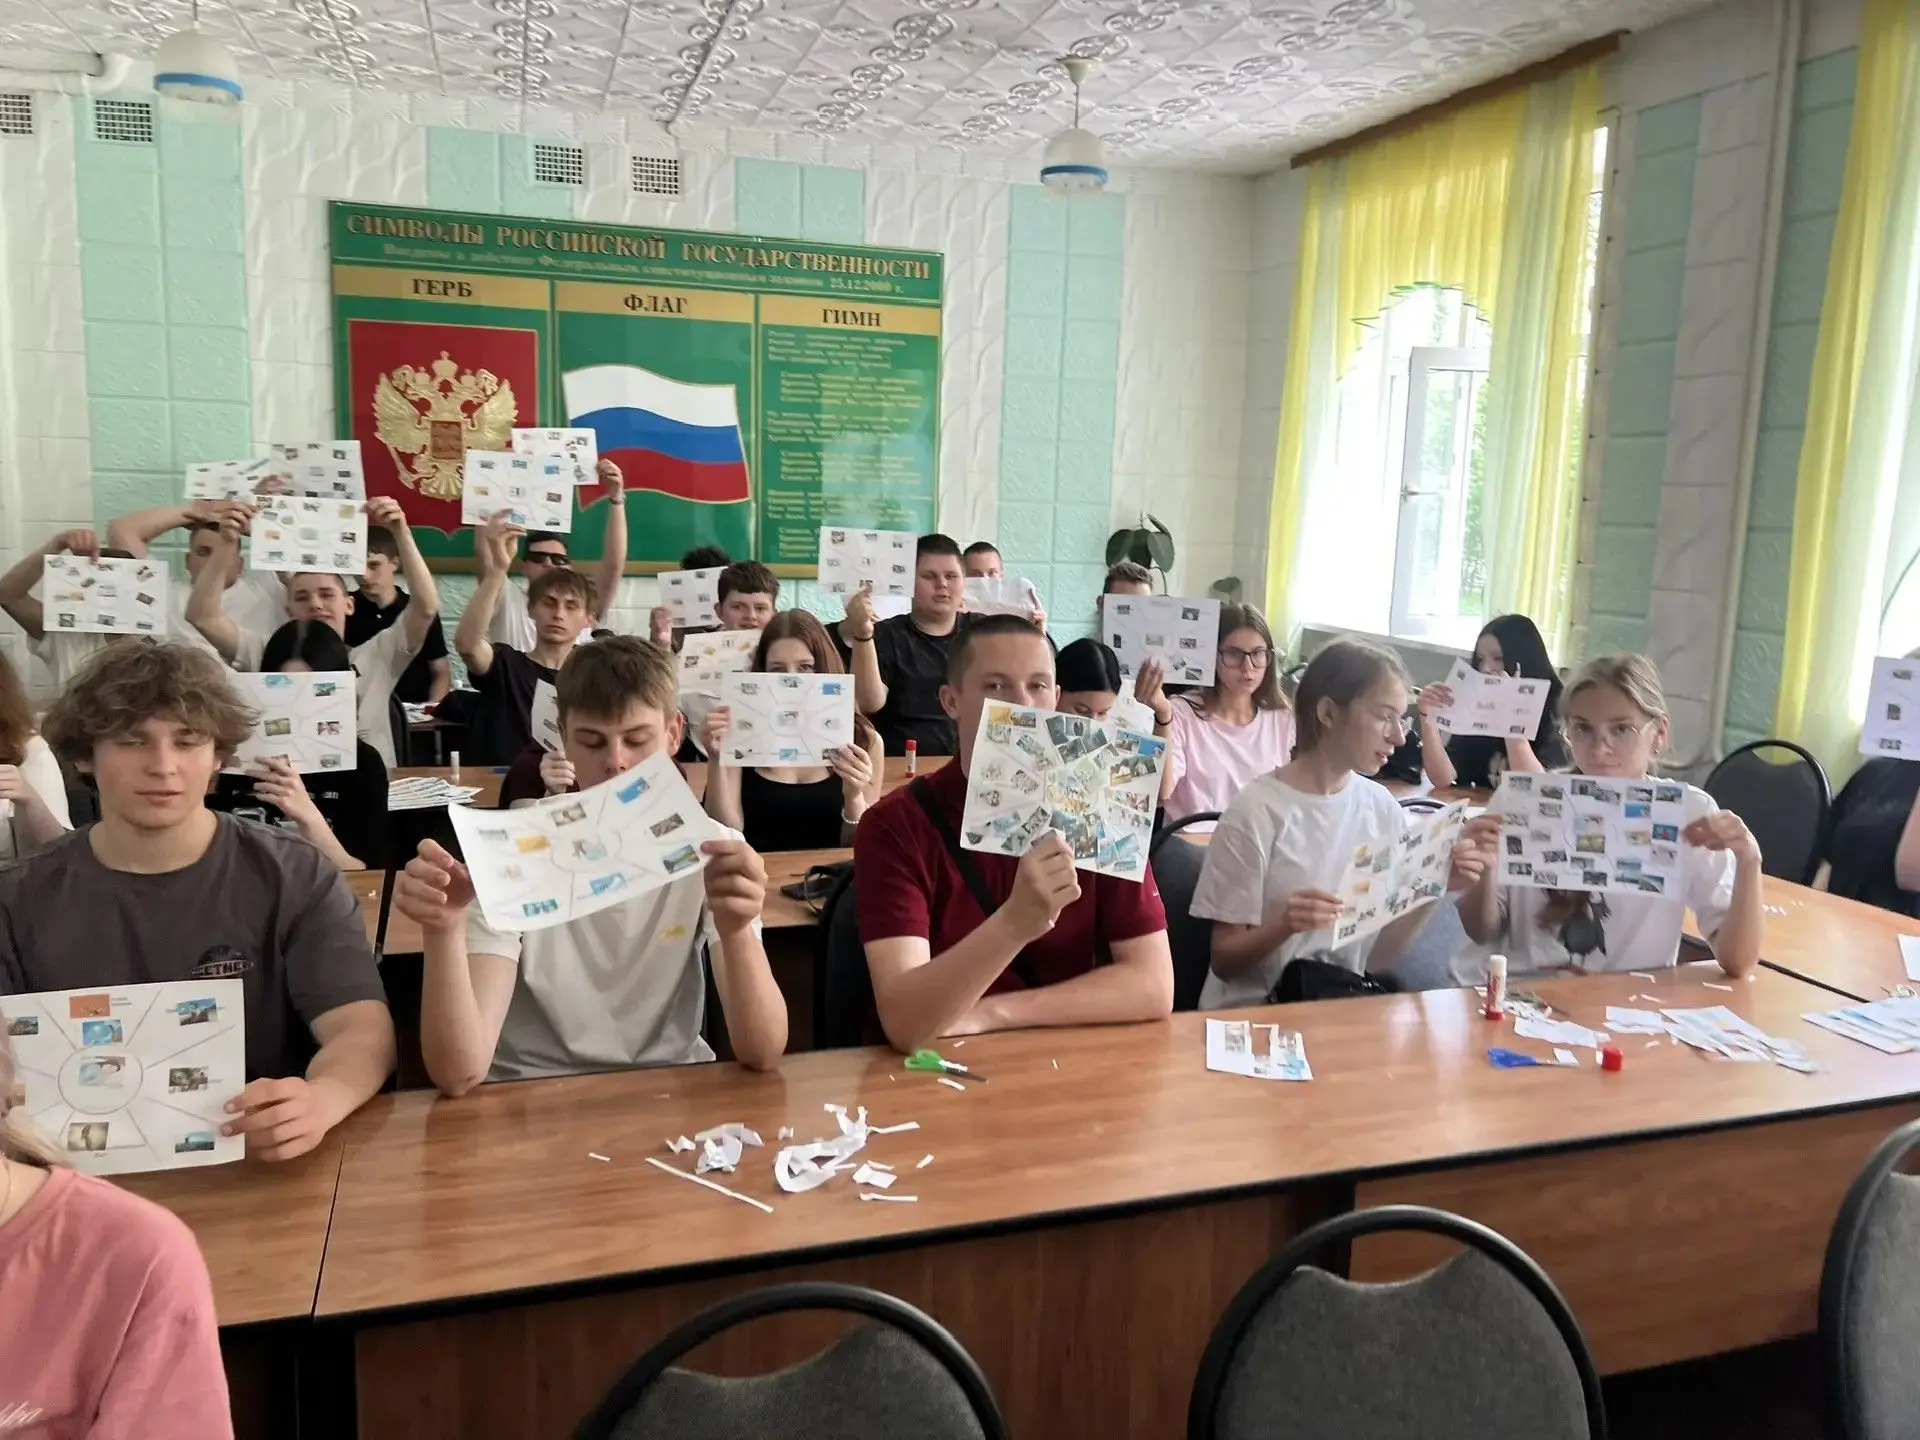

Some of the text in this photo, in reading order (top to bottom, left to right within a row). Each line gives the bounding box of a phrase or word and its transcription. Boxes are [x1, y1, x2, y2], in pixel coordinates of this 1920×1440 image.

[346, 214, 930, 280] СИМВОЛЫ РОССИЙСКОЙ ГОСУДАРСТВЕННОСТИ
[411, 278, 473, 298] ГЕРБ
[624, 293, 689, 315] ФЛАГ
[822, 308, 882, 327] ГИМН
